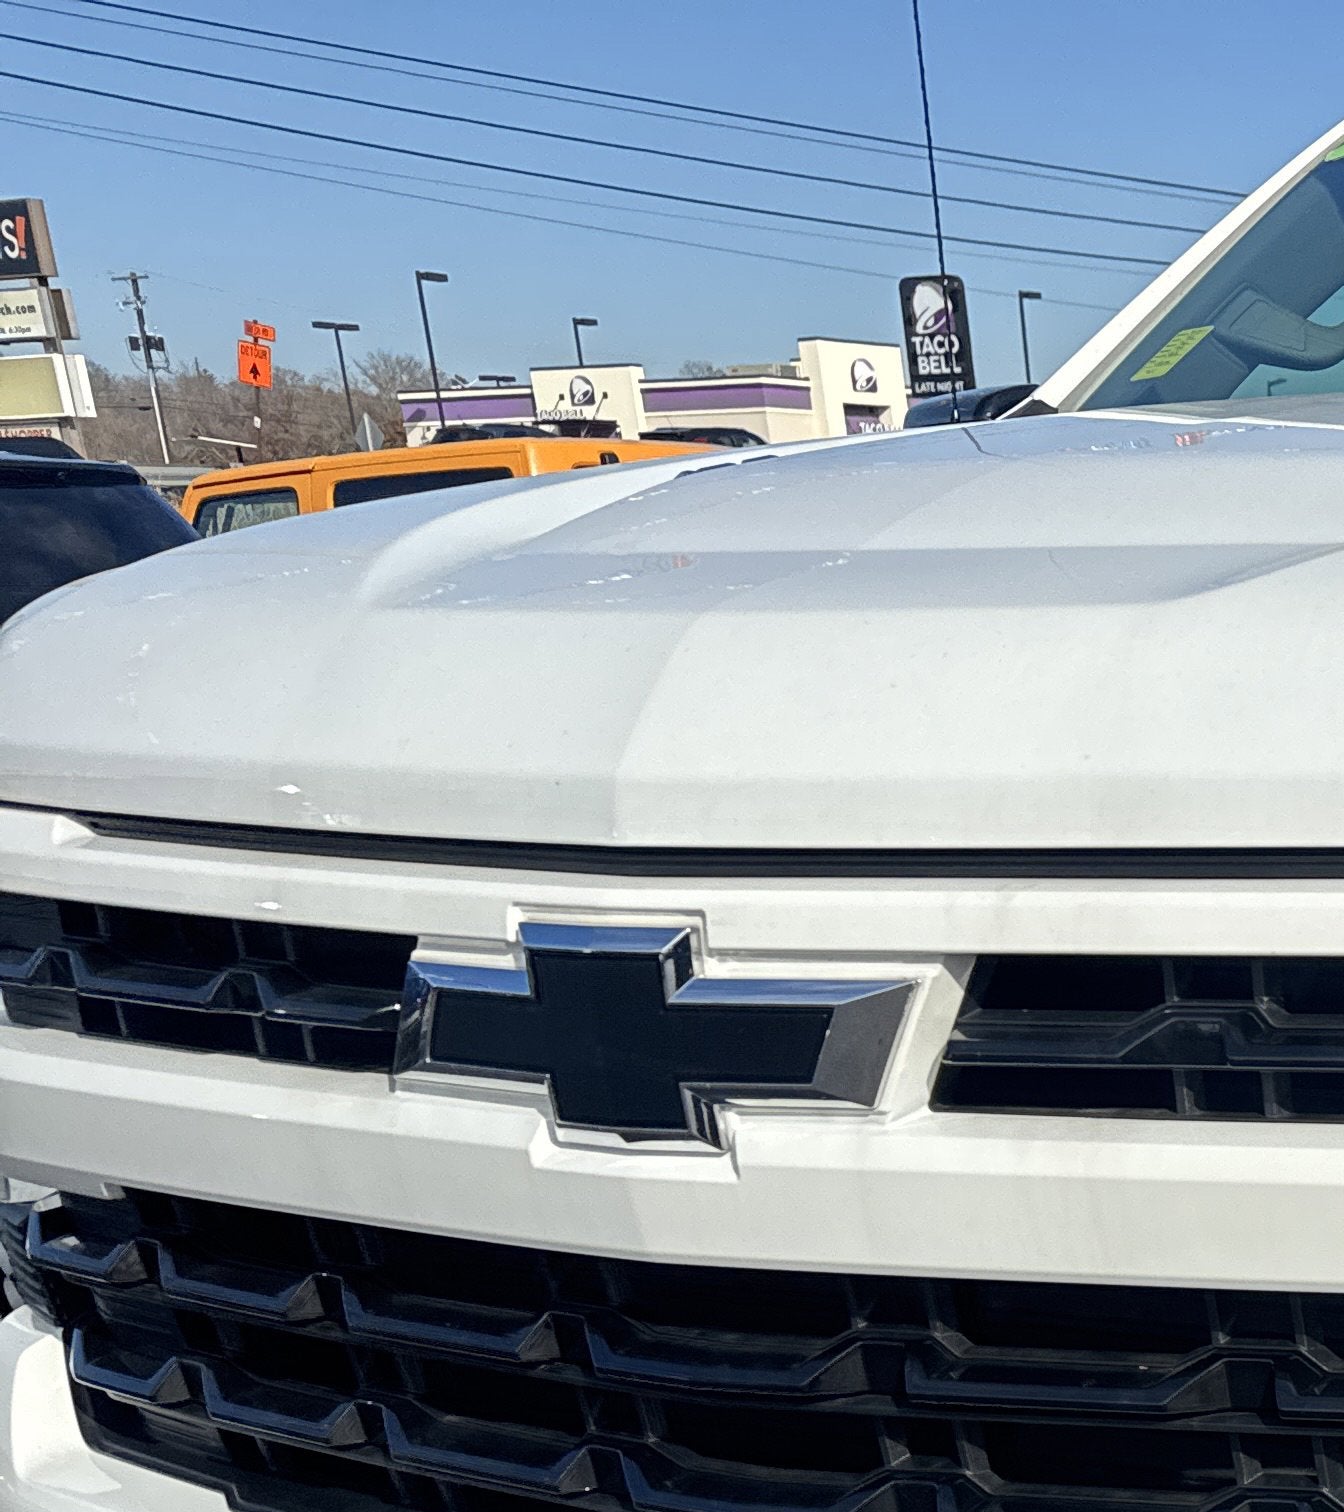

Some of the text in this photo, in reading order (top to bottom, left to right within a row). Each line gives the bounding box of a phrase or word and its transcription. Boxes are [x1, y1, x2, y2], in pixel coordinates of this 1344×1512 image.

[0, 216, 27, 260] S!
[911, 334, 960, 356] TACO
[916, 354, 963, 376] BELL
[914, 381, 936, 394] LATE
